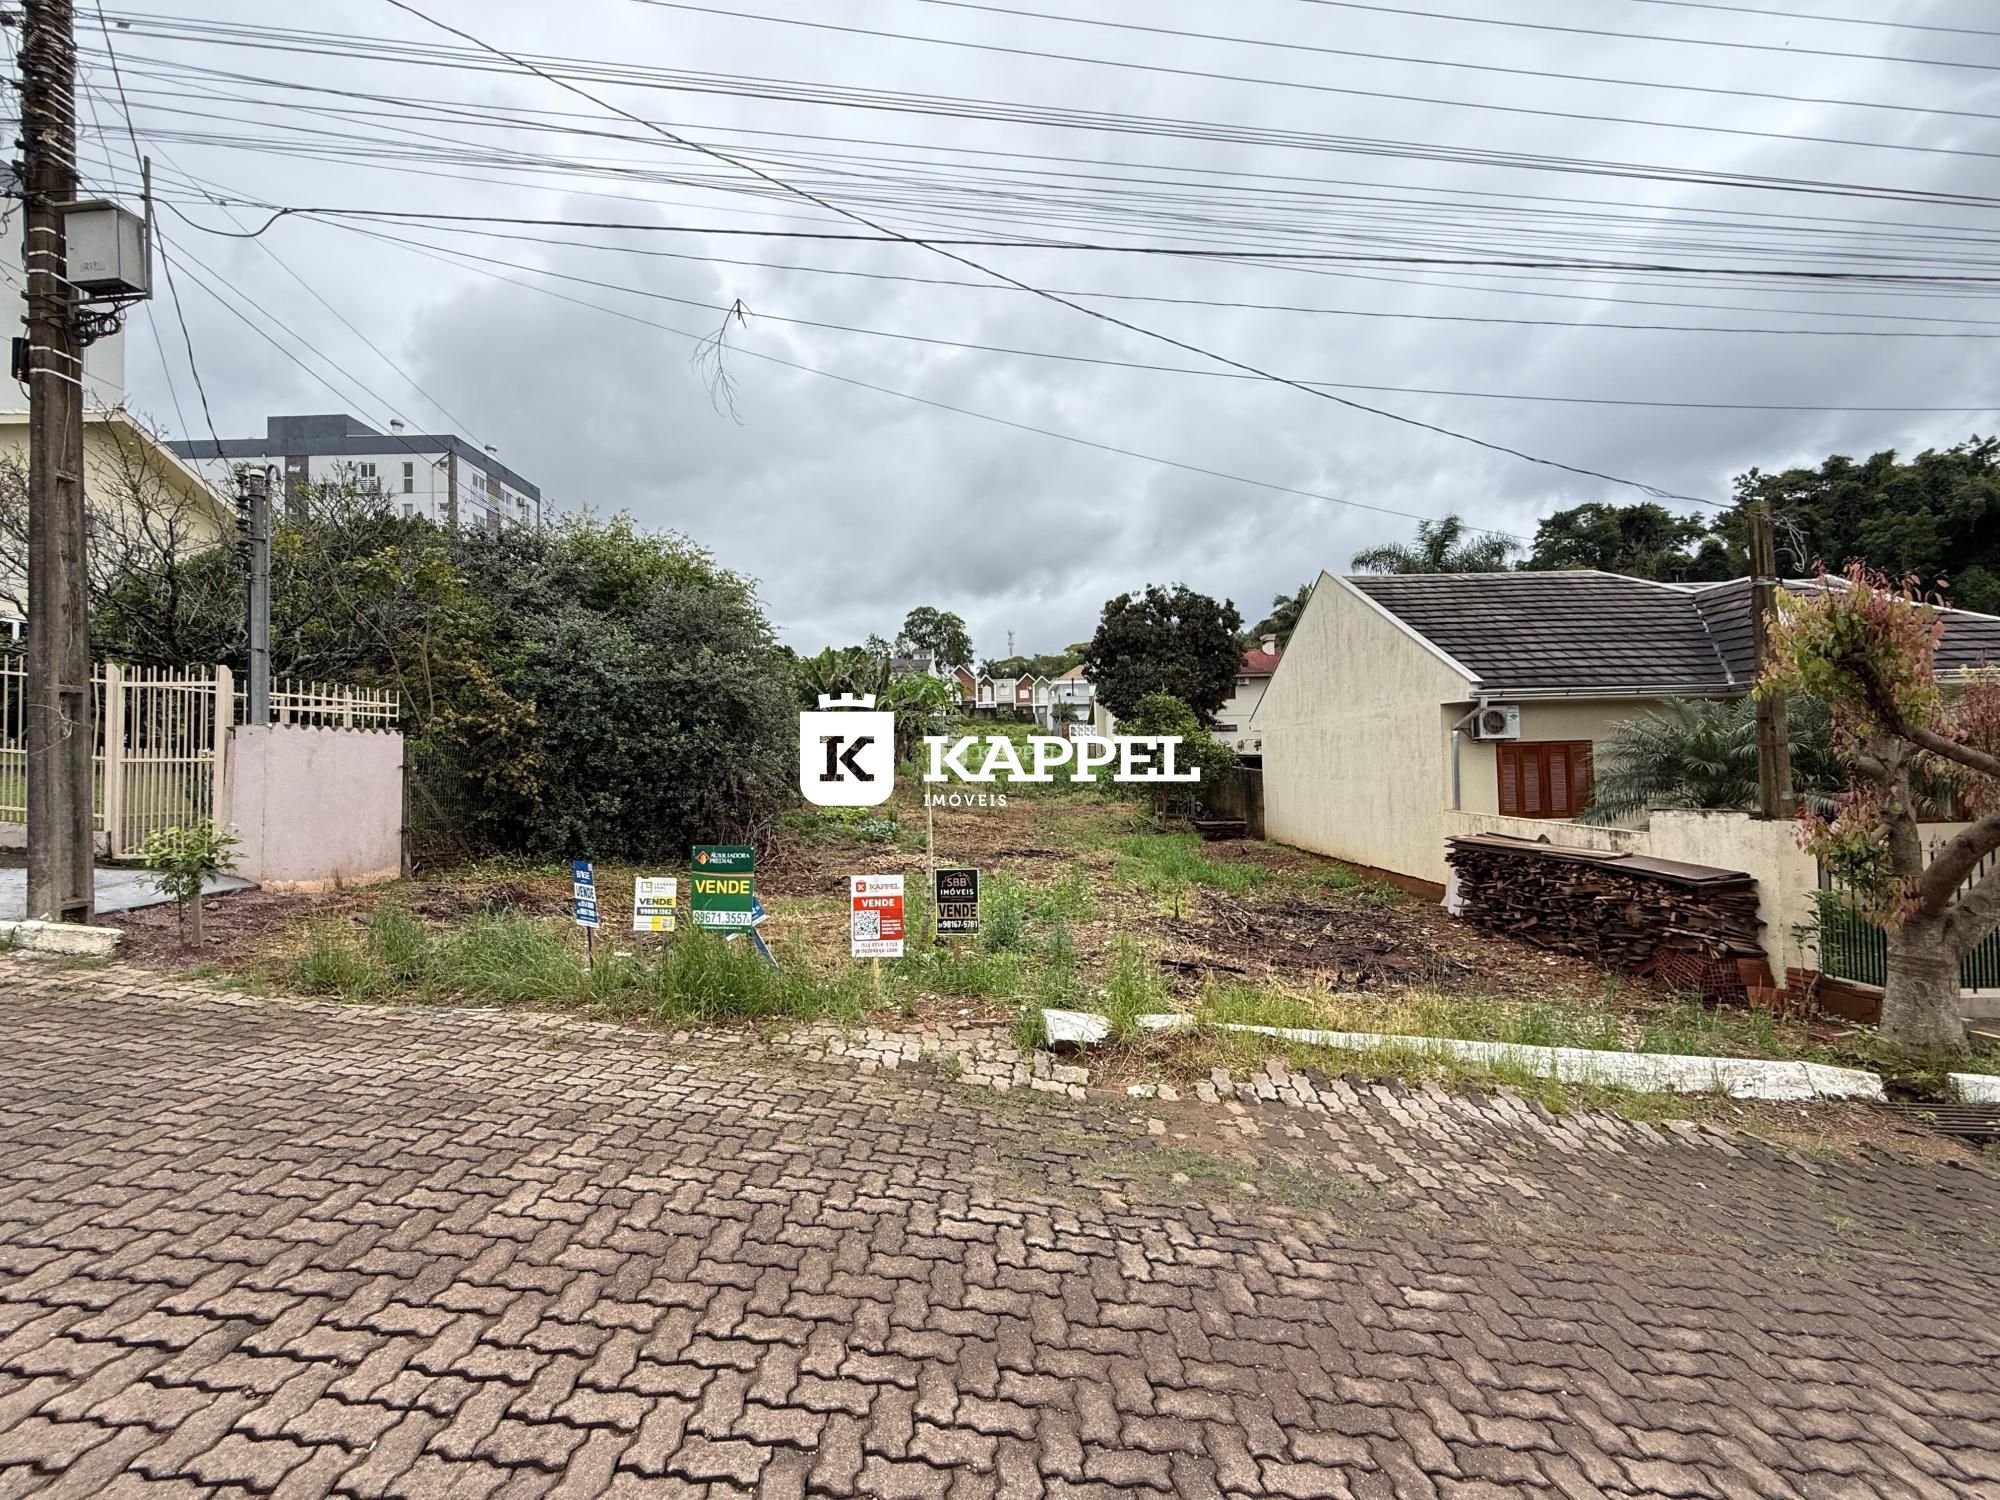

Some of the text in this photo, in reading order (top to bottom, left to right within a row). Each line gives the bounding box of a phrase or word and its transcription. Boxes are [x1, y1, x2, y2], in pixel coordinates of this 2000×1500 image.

[695, 879, 750, 894] VENDE
[946, 877, 967, 887] SBB
[576, 885, 595, 900] VENDE
[940, 888, 975, 896] IMÓVEIS
[639, 898, 673, 906] VENDE
[861, 898, 895, 908] VENDE
[938, 904, 977, 918] VENDE
[694, 911, 747, 924] 99671.3557
